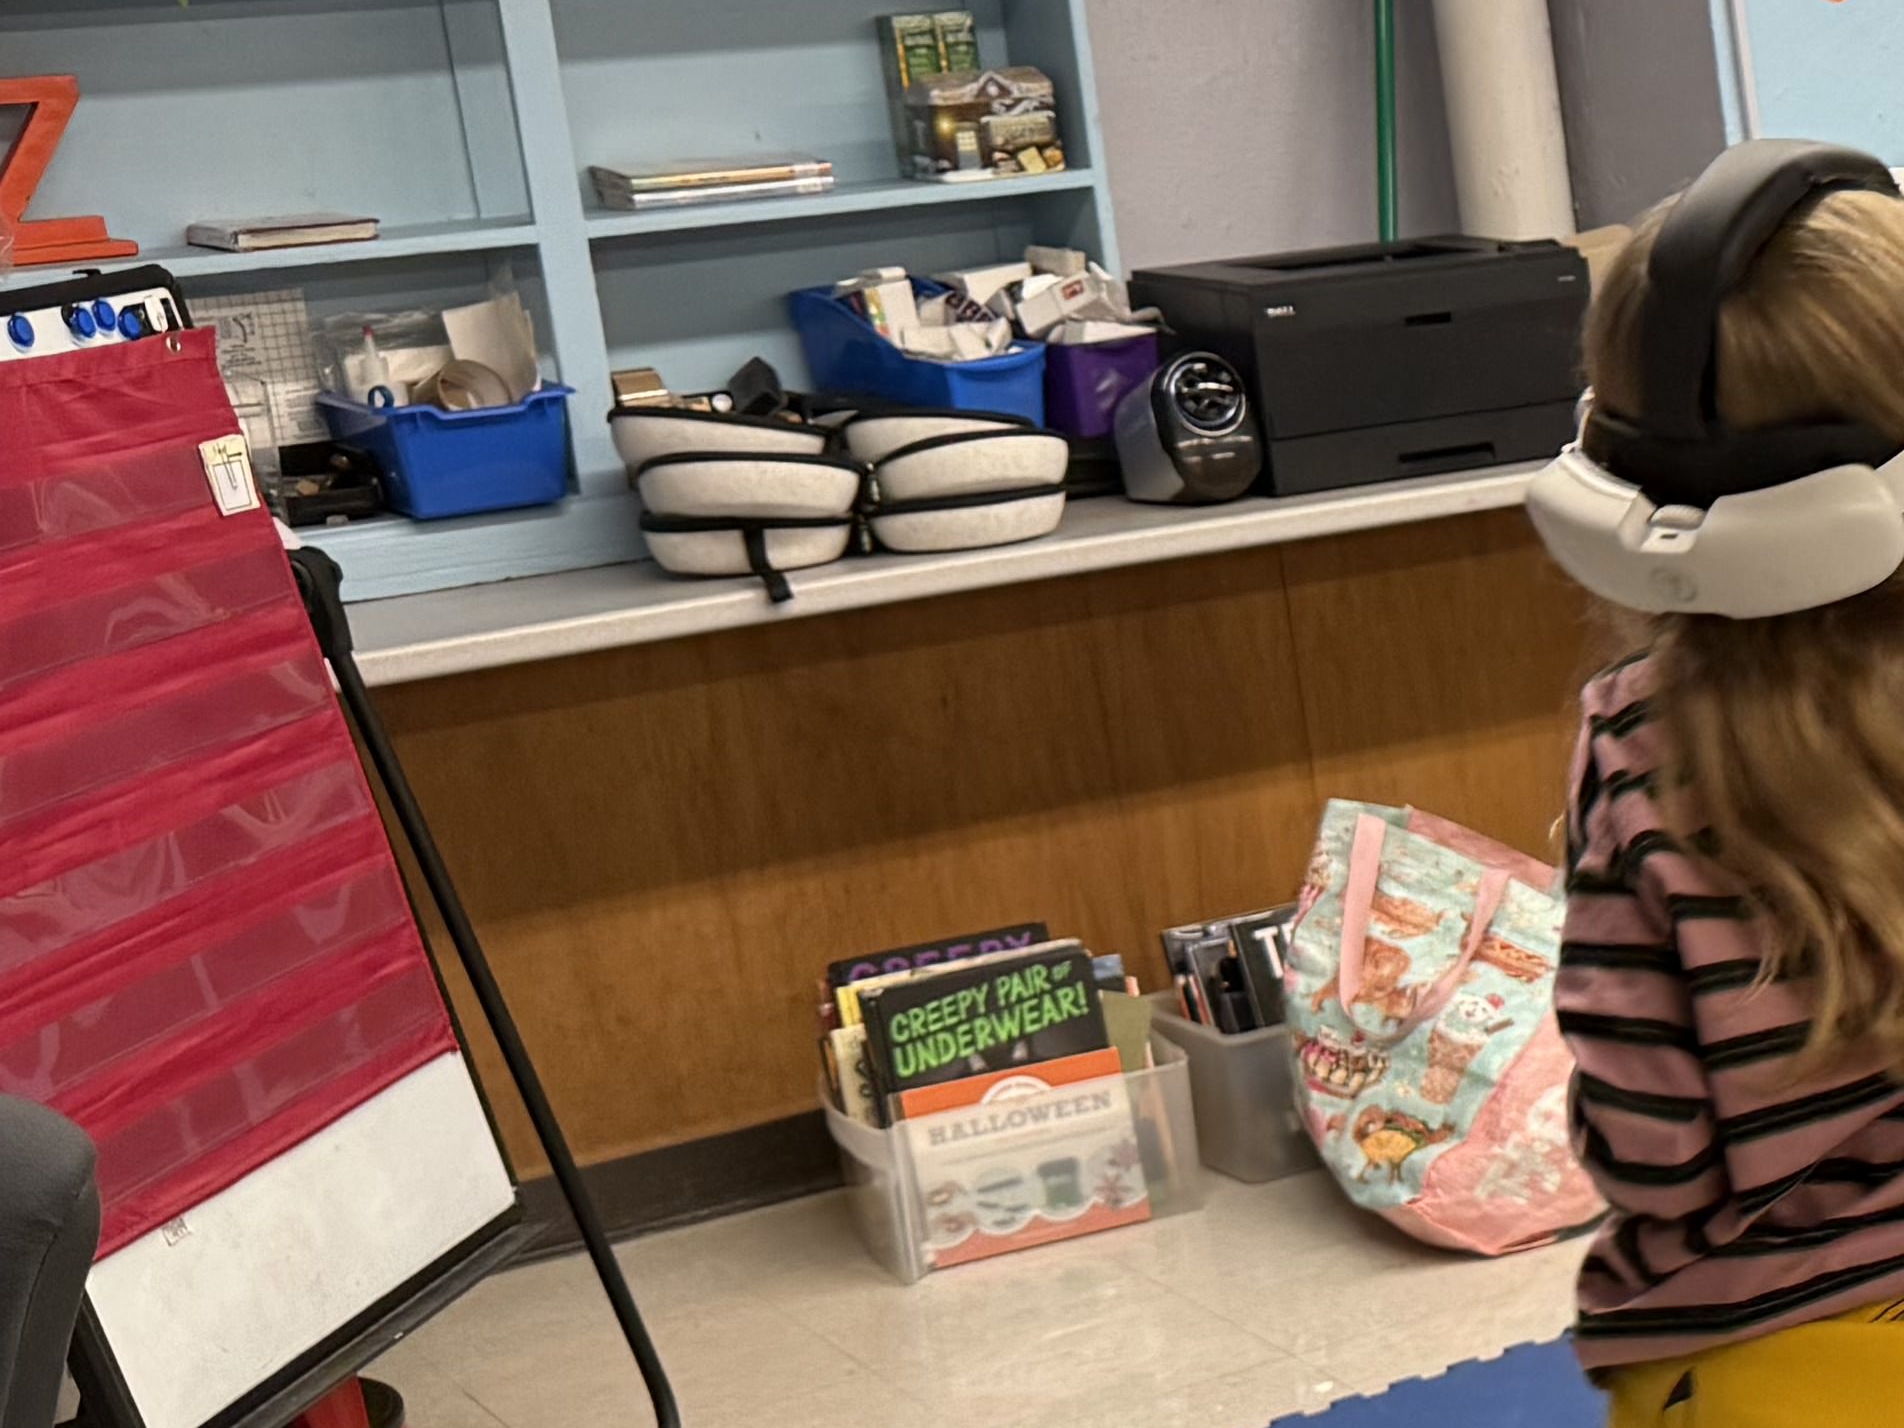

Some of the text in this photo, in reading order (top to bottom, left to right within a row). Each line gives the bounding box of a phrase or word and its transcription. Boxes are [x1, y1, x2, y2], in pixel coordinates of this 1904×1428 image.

[889, 983, 989, 1044] CREEPY
[996, 963, 1051, 1008] PAIR
[893, 981, 1090, 1079] UNDERWEAR!
[928, 1089, 1113, 1147] HALLOWEEN
